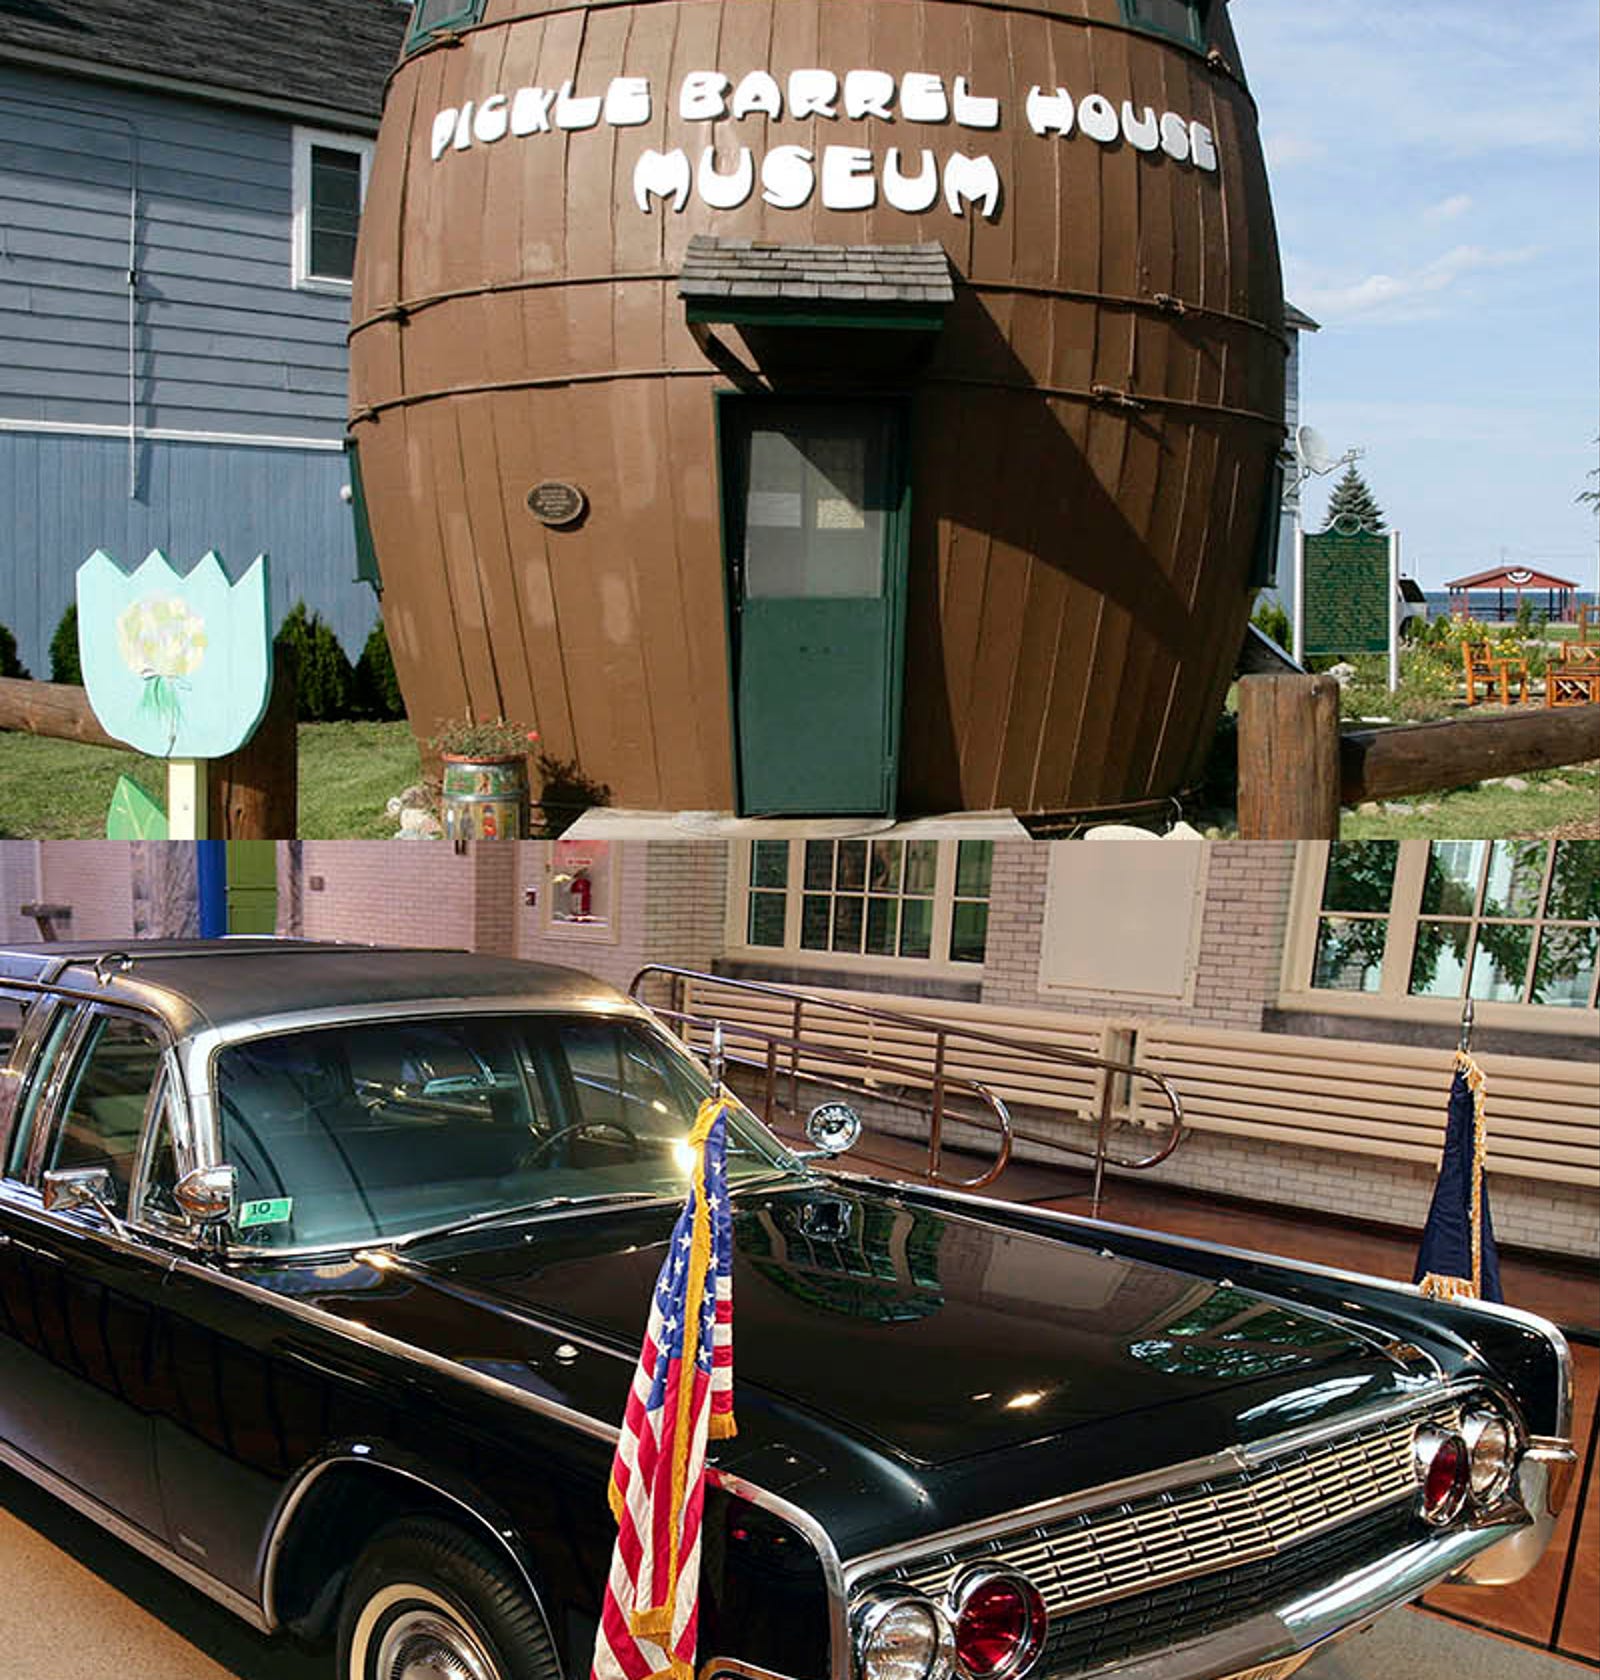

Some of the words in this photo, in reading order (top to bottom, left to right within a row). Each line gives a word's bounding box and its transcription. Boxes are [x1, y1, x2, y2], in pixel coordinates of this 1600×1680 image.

[431, 76, 651, 161] PICKLE
[678, 69, 1000, 129] BARREL
[1025, 84, 1217, 172] HOUSE
[633, 144, 1000, 217] MUSEUM
